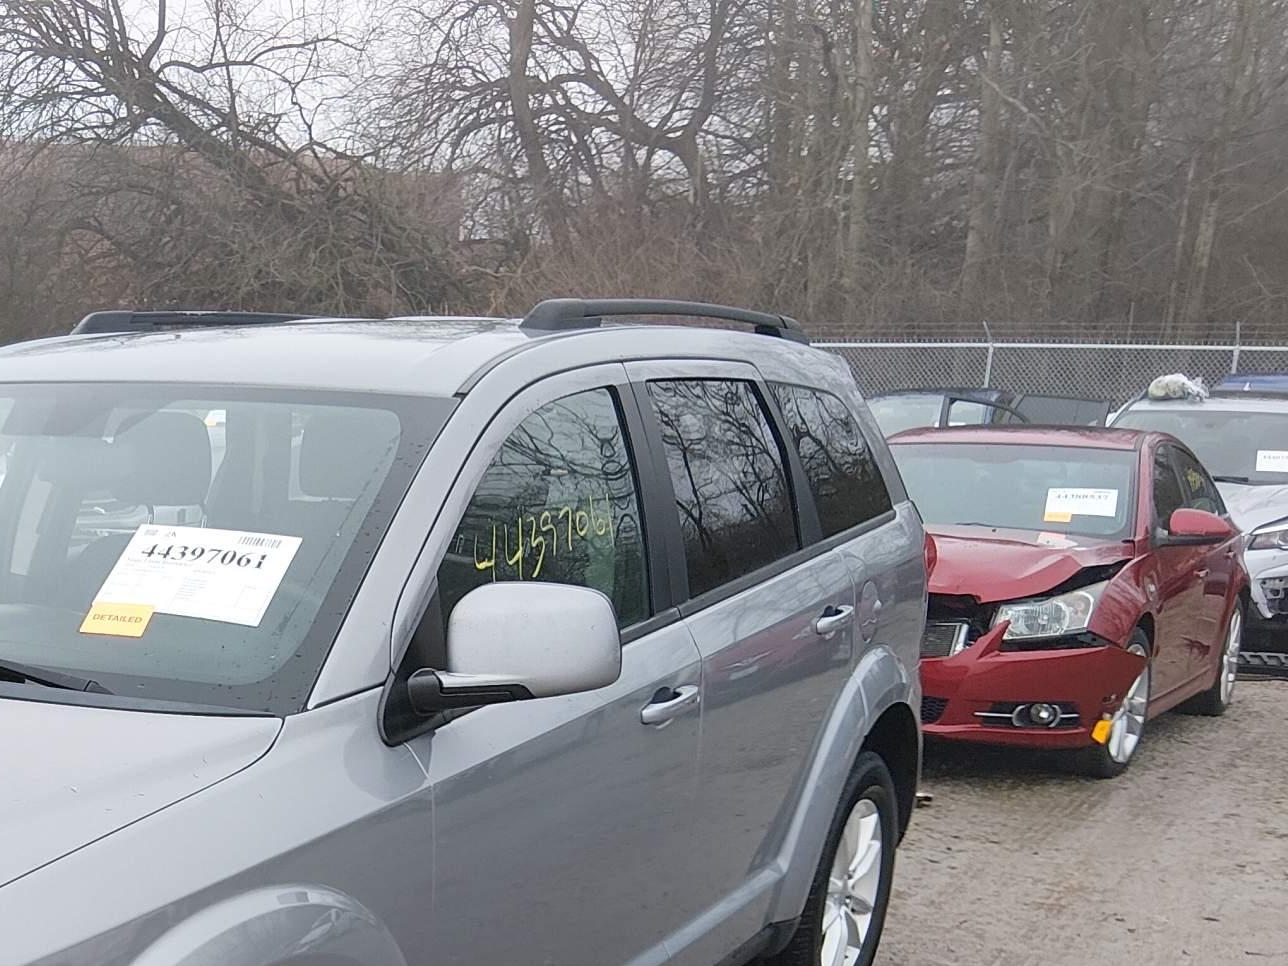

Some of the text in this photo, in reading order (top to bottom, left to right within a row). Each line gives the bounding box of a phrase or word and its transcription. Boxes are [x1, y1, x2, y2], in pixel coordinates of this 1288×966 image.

[474, 493, 615, 584] 44397061
[140, 543, 268, 570] 44397061
[92, 613, 143, 624] DETAILED
